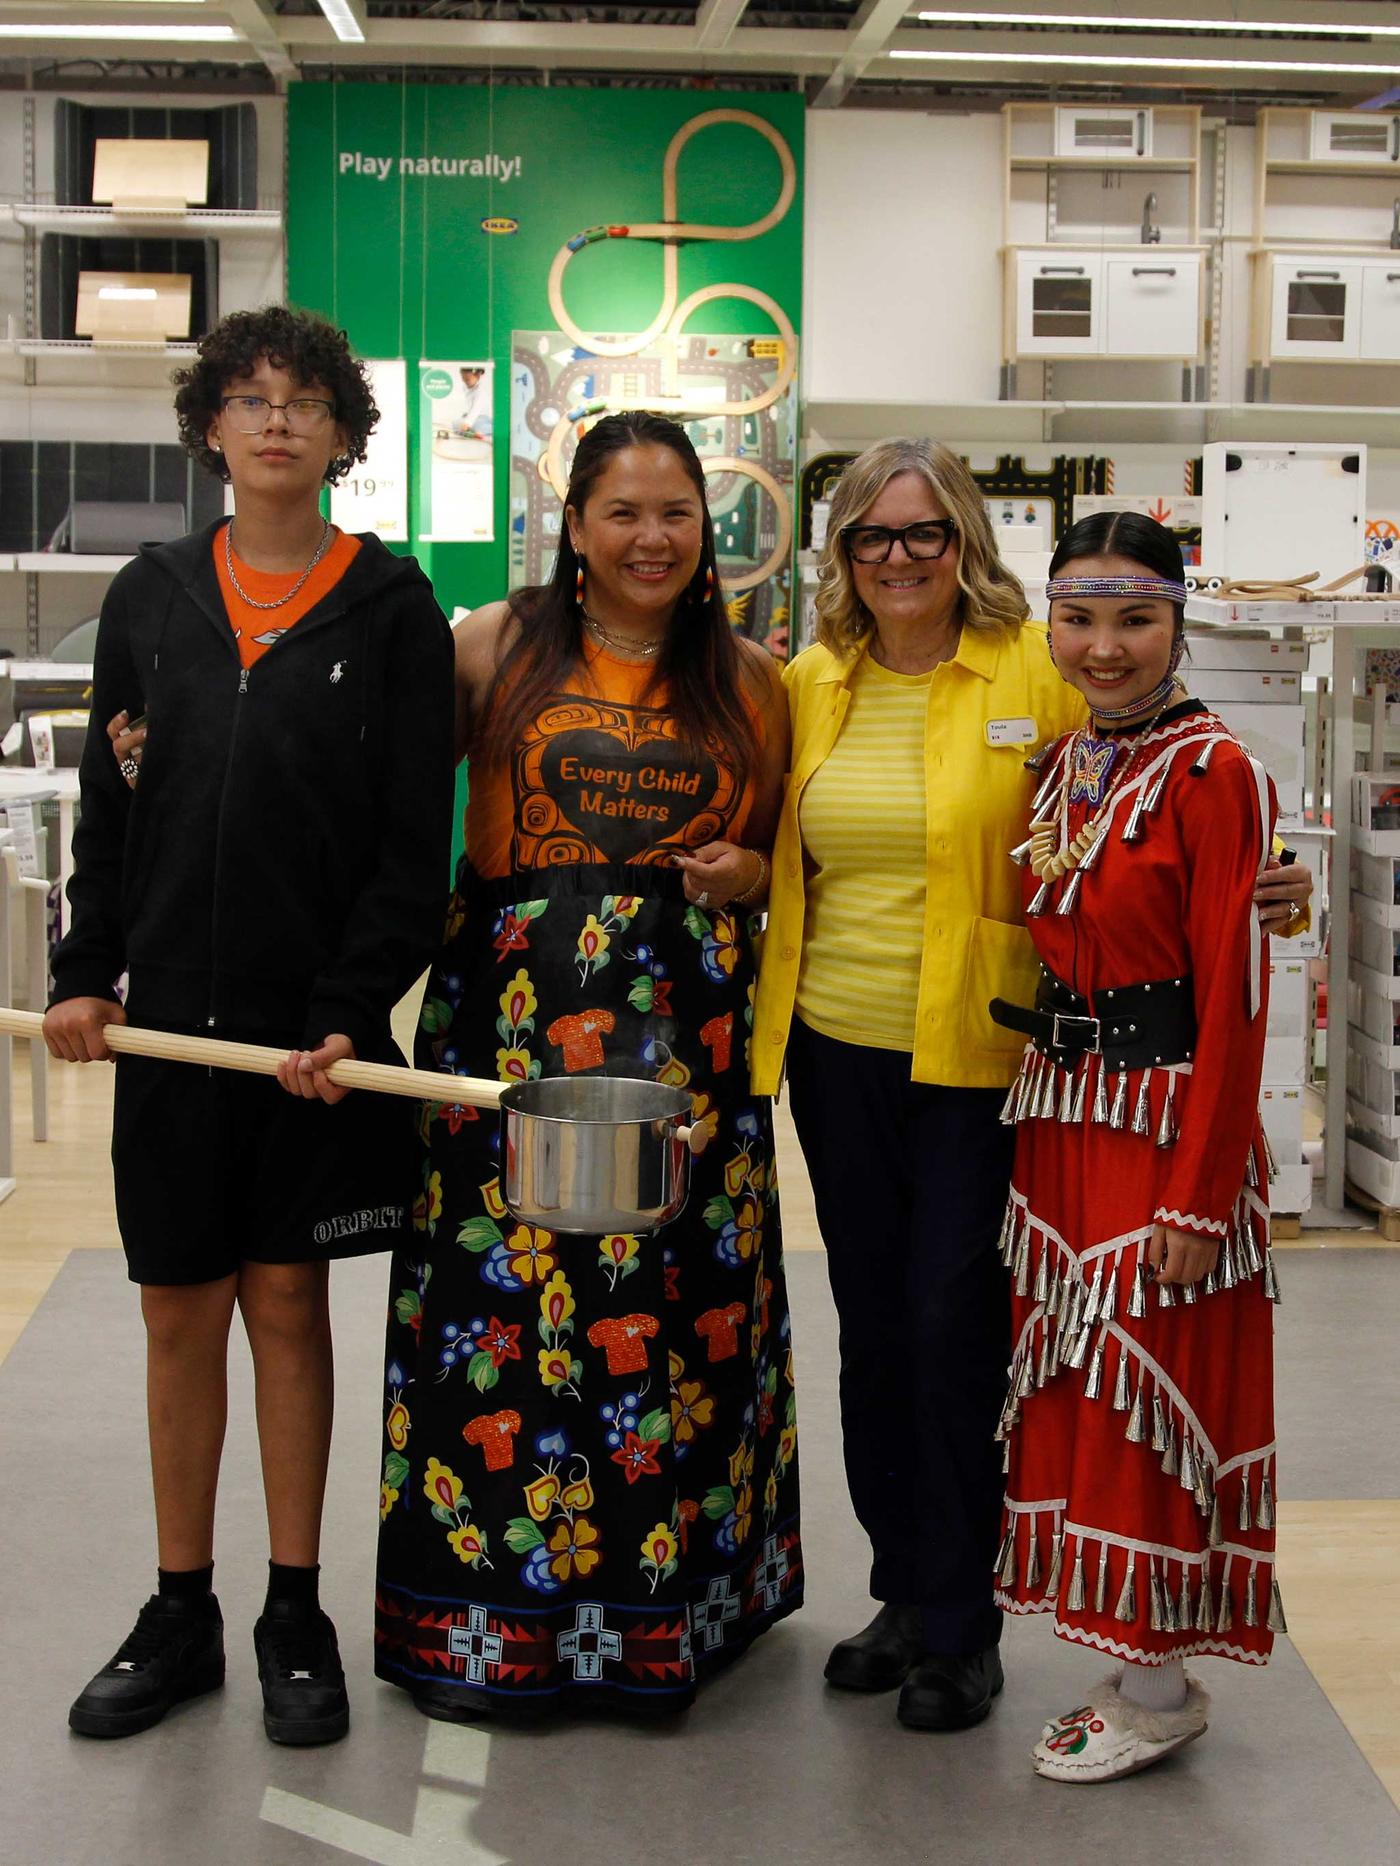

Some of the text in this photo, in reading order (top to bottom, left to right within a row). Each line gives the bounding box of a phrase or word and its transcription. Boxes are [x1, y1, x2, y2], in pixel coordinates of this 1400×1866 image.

[339, 152, 522, 183] Play naturally!
[559, 757, 701, 797] Every Child
[579, 790, 670, 822] Matters
[313, 1206, 404, 1244] ORBIT
